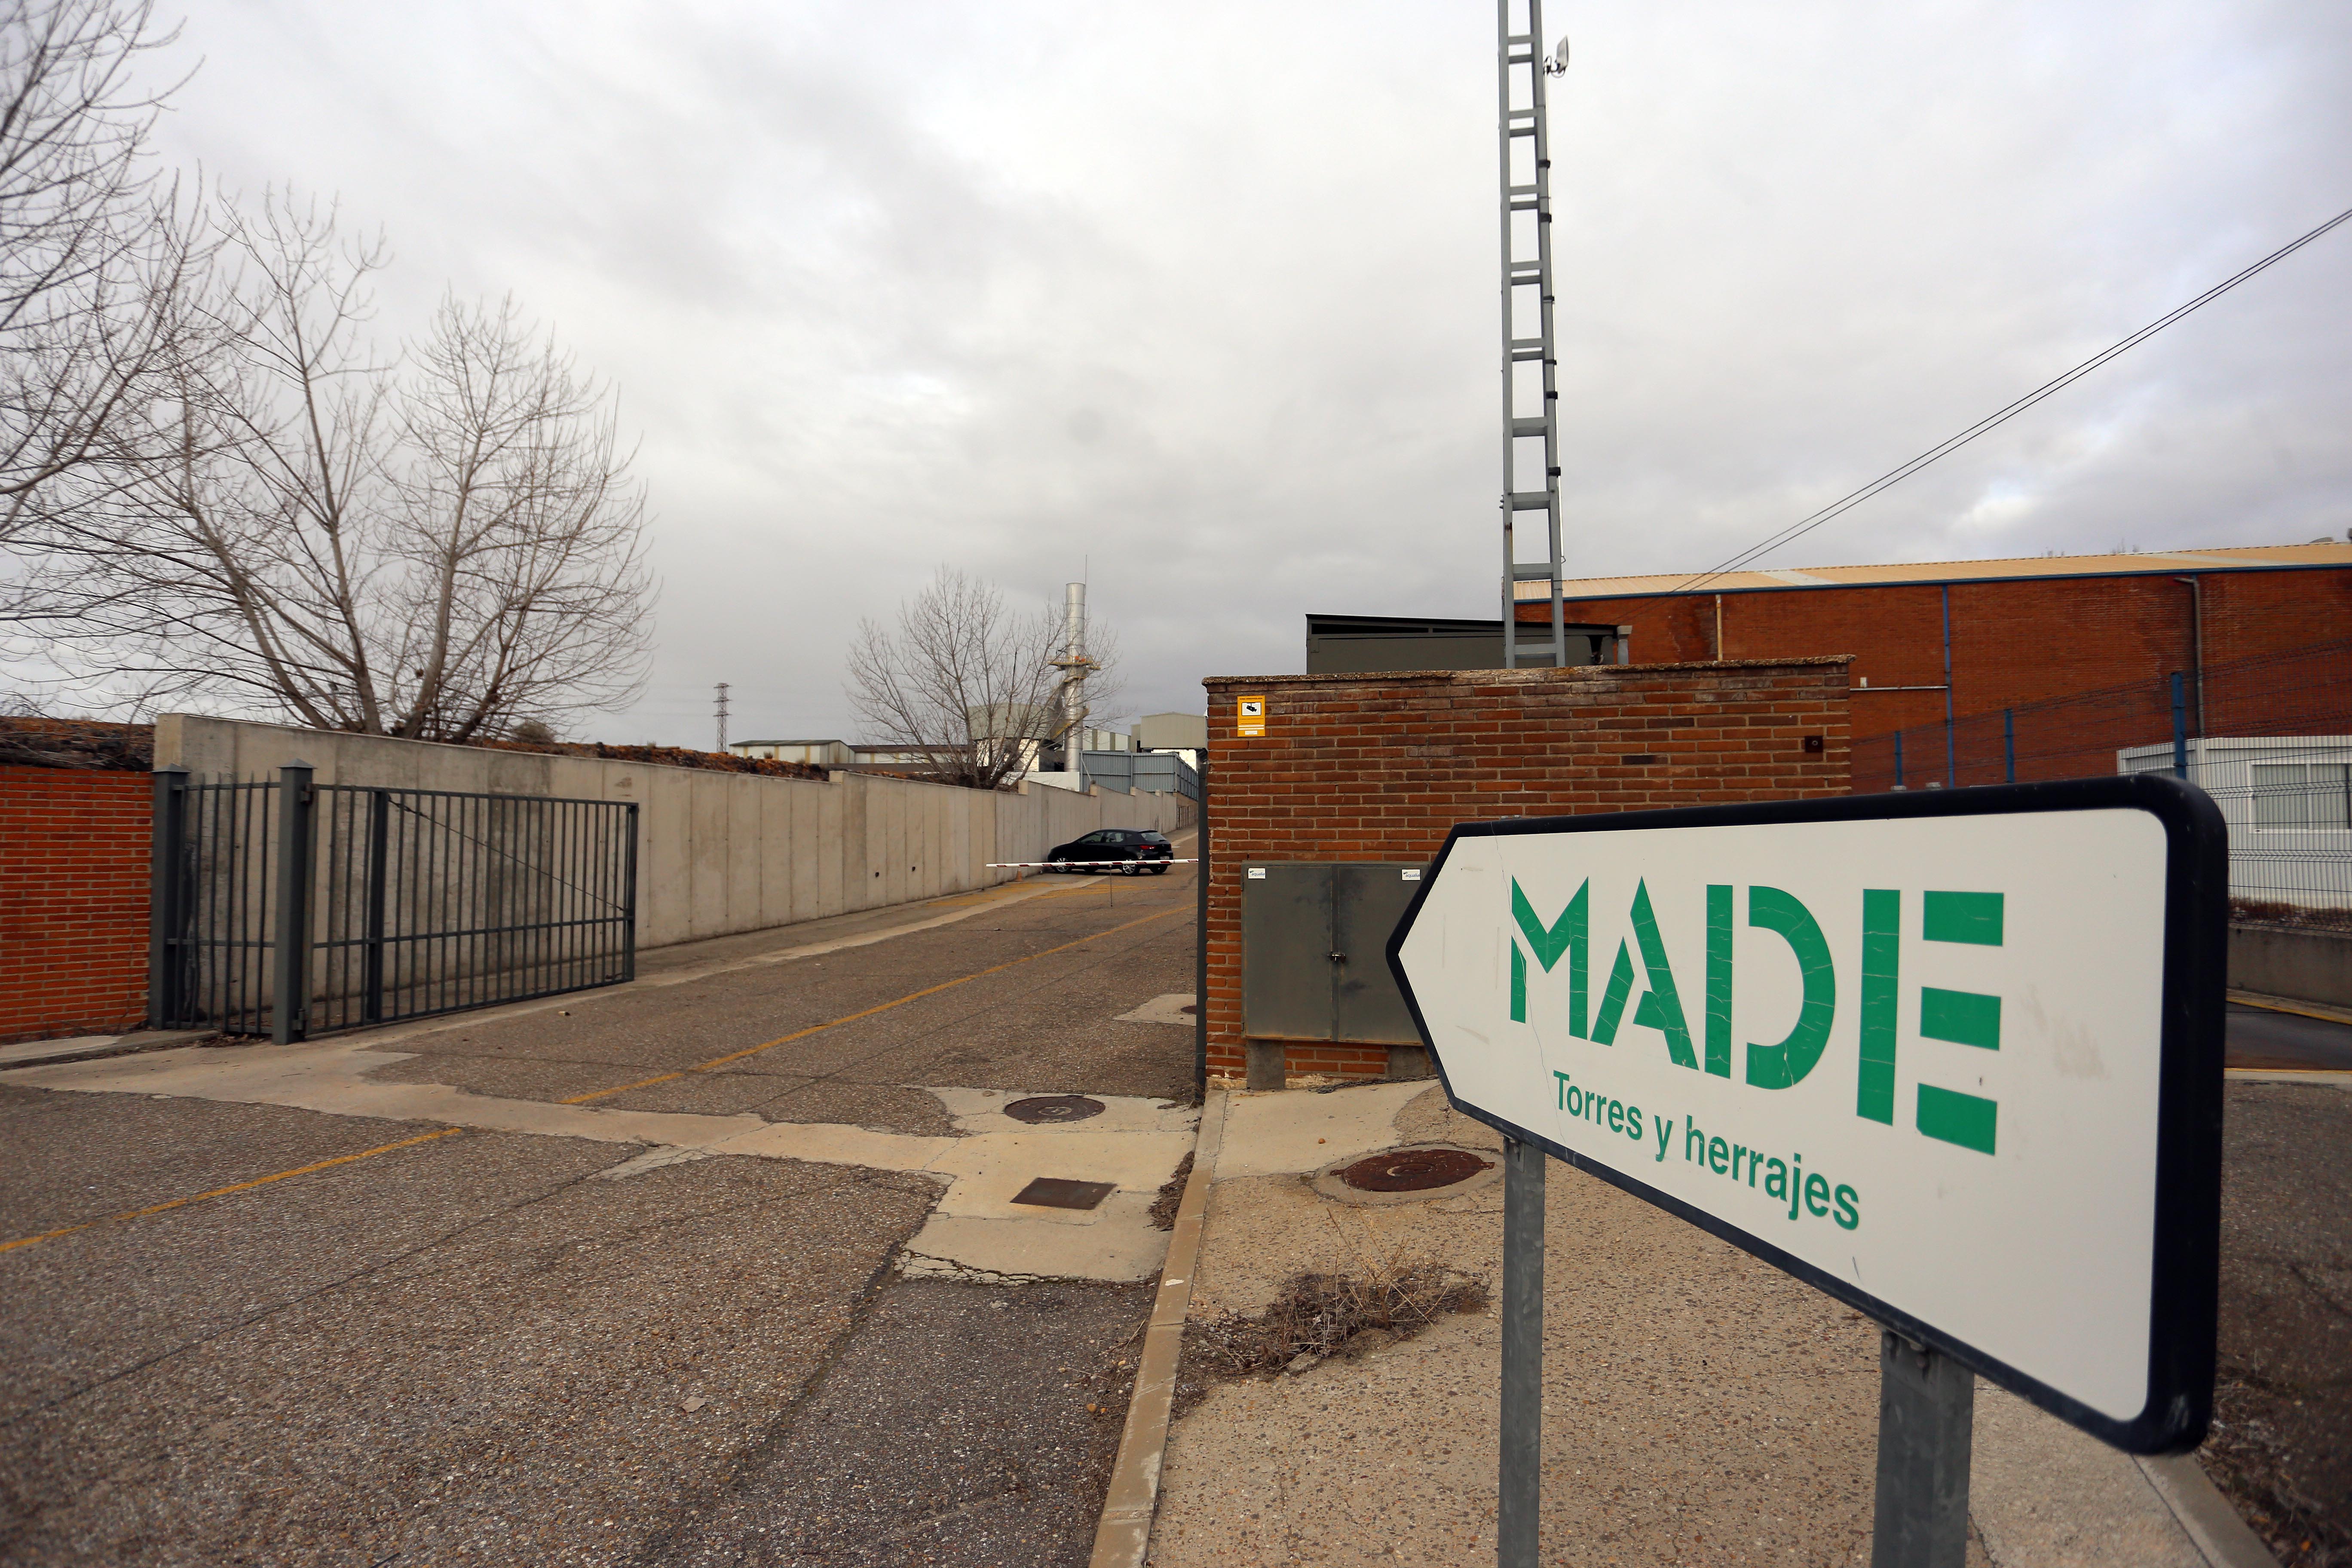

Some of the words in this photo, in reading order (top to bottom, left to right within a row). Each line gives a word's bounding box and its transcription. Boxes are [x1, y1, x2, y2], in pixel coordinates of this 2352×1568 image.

[1510, 876, 2004, 1156] MADE
[1553, 1070, 1642, 1140] Torres
[1654, 1115, 1673, 1162] y
[1686, 1115, 1859, 1230] herrajes
